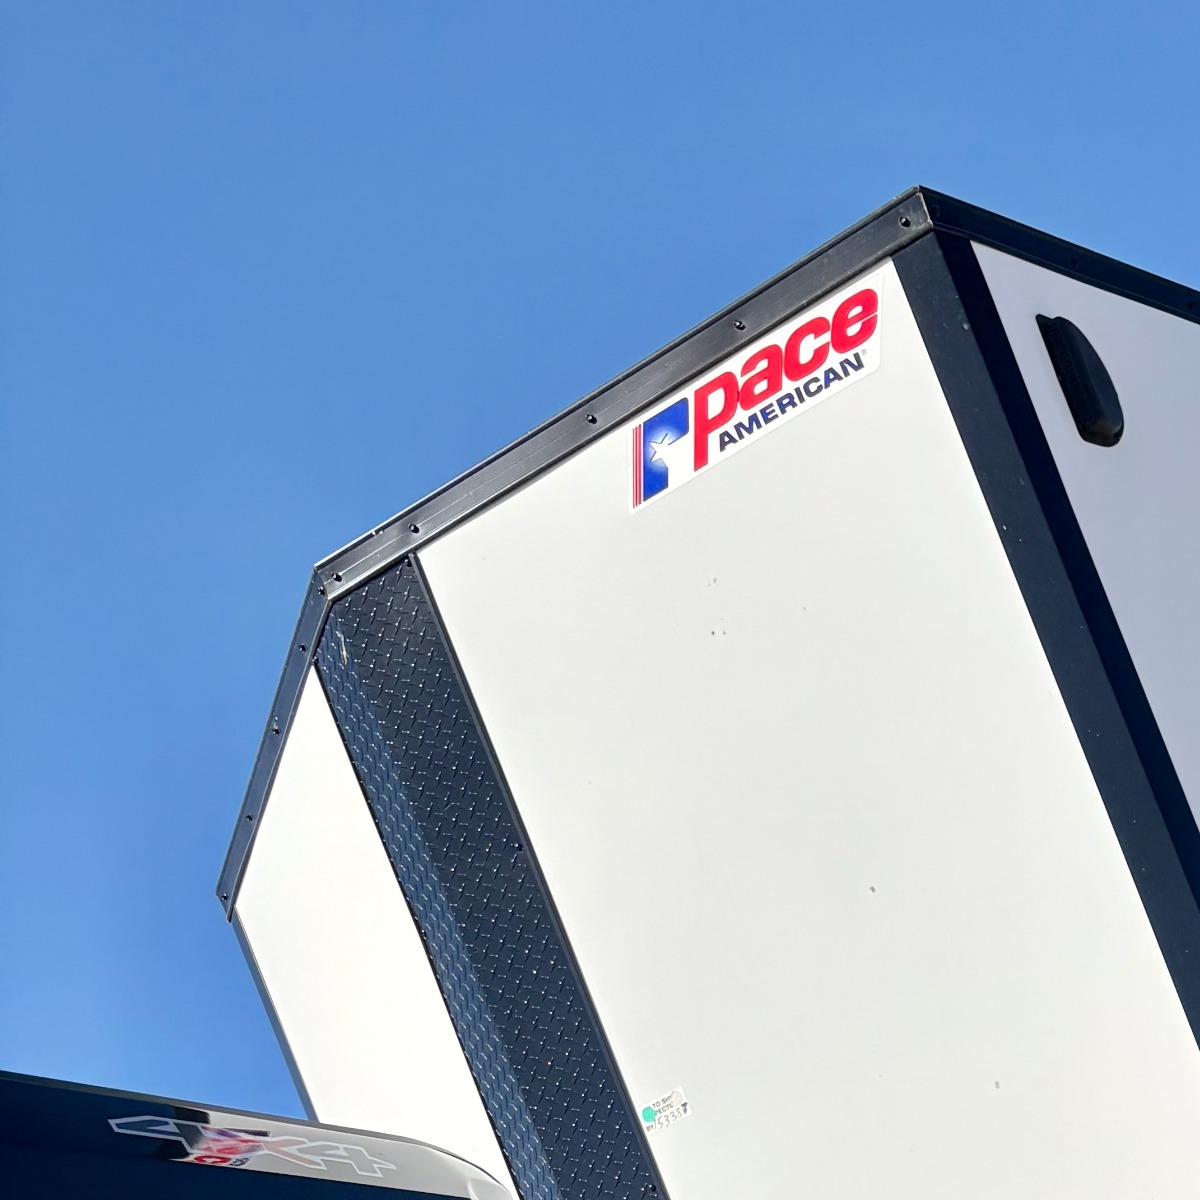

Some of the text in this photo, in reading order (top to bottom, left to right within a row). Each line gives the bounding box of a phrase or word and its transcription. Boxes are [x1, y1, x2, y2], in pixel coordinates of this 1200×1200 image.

[693, 288, 879, 473] pace
[718, 351, 865, 453] AMERICAN
[652, 1101, 661, 1109] TO
